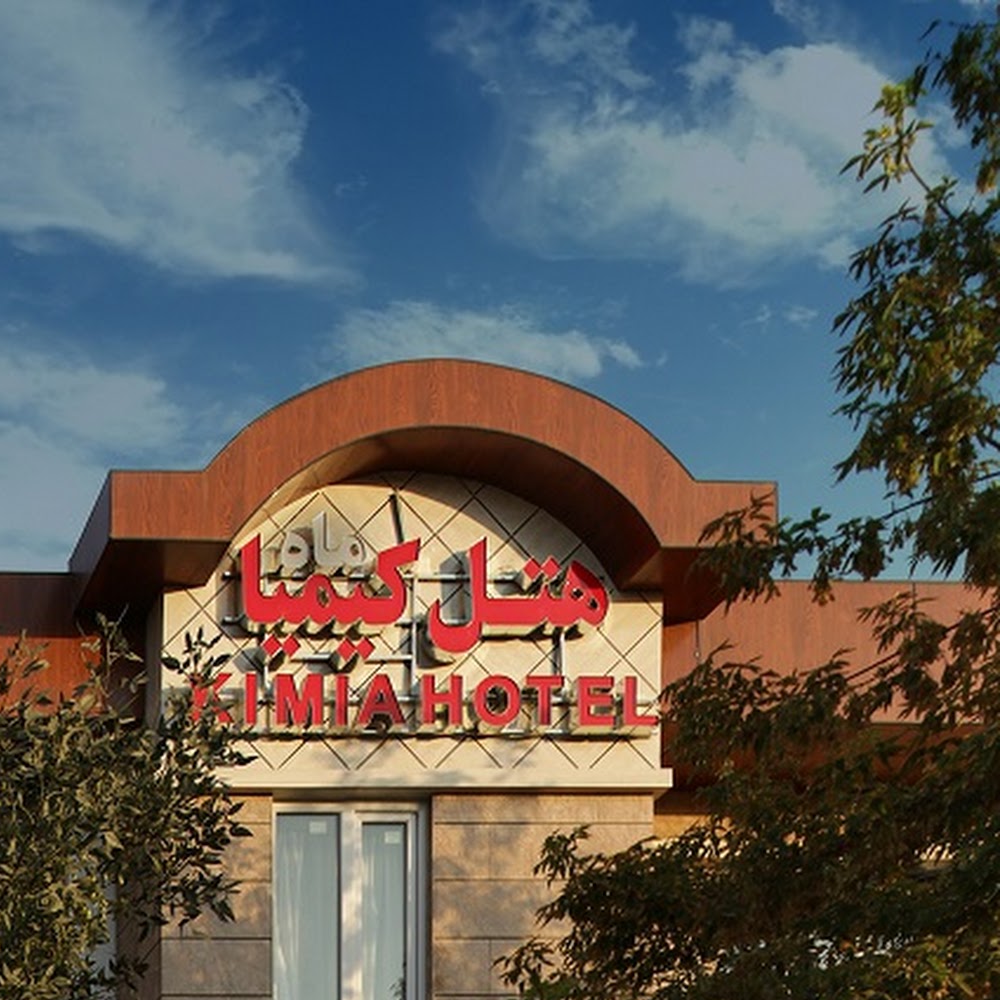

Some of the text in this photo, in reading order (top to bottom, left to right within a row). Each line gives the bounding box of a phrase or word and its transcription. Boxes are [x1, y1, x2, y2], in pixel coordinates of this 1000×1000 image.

[281, 511, 367, 570] ماه
[240, 533, 611, 663] هتل کیمیا
[190, 672, 660, 727] KIMIA HOTEL
